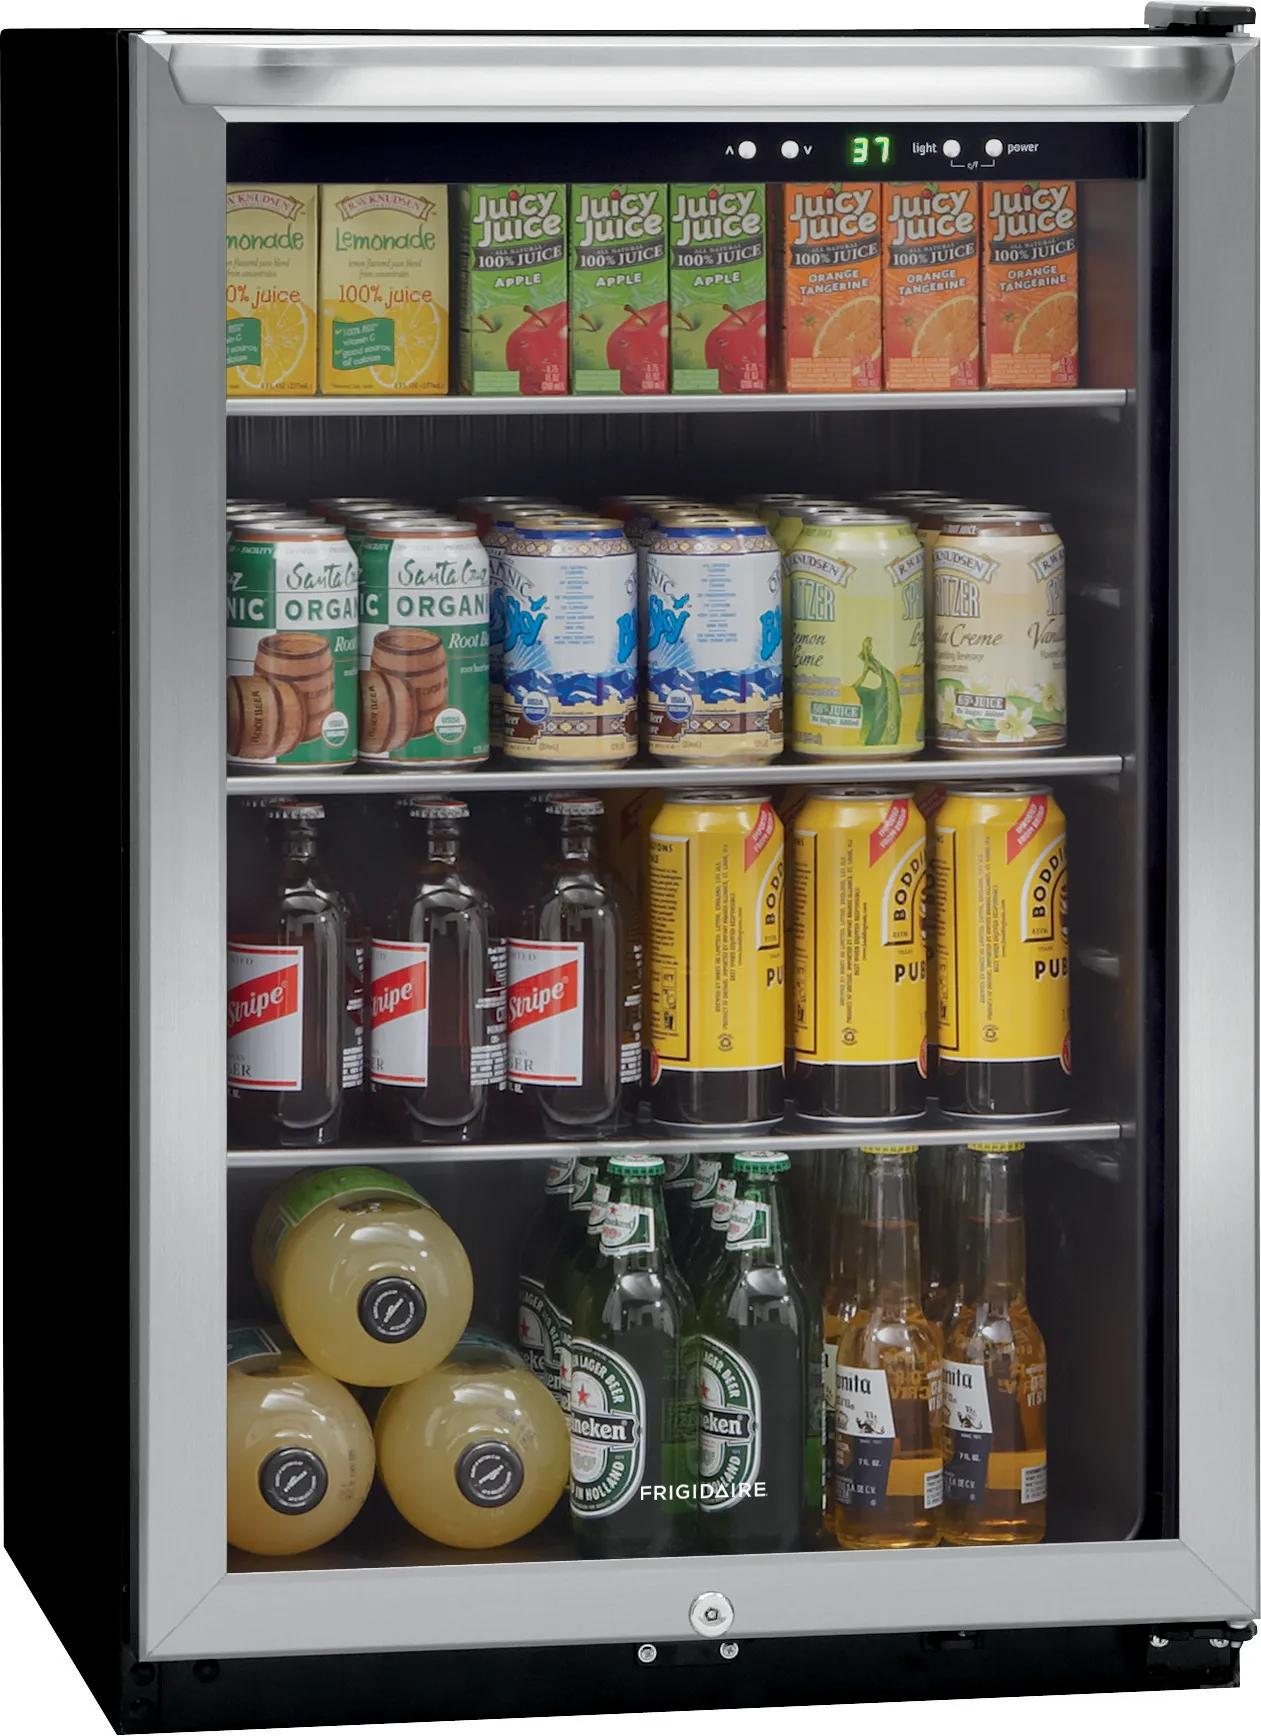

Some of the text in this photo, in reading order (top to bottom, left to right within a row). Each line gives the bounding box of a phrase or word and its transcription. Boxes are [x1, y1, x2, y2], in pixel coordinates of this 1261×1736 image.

[852, 136, 890, 164] 37
[912, 142, 938, 156] light
[1007, 142, 1040, 155] power
[473, 189, 557, 223] Juicy
[575, 188, 657, 222] Juicy
[672, 188, 755, 222] Juicy
[790, 188, 873, 221] Juicy
[888, 189, 969, 221] Juicy
[988, 185, 1069, 218] Juicy
[335, 222, 436, 251] Lemonade
[478, 214, 561, 247] Juice
[580, 214, 662, 247] Juice
[677, 213, 761, 247] Juice
[794, 211, 877, 246] Juice
[892, 212, 974, 246] Juice
[992, 208, 1074, 241] Juice
[479, 245, 562, 268] 100% JUICE
[580, 245, 662, 268] 100% JUICE
[677, 244, 761, 267] 100% JUICE
[795, 242, 878, 266] 100% JUICE
[893, 242, 975, 266] 100% JUICE
[994, 239, 1076, 262] 100% JUICE
[494, 273, 542, 288] APPLE
[596, 272, 642, 287] APPLE
[694, 272, 740, 287] APPLE
[808, 269, 859, 283] ORANGE
[906, 269, 957, 283] ORANGE
[1000, 275, 1067, 292] TANGERINE
[1007, 265, 1057, 279] ORANGE
[251, 286, 302, 310] juice
[338, 284, 433, 309] 100% juice
[800, 278, 869, 295] TANGERINE
[898, 278, 966, 296] TANGERINE
[286, 562, 343, 590] Santa
[398, 559, 459, 586] Santa
[448, 632, 479, 649] Root
[950, 623, 1004, 648] Creme
[974, 697, 1004, 709] JUICE
[894, 960, 926, 984] PUB
[1034, 957, 1067, 979] PUB
[227, 985, 284, 1027] Stripe
[509, 981, 564, 1022] Stripe
[605, 1374, 626, 1404] BEER
[721, 1369, 741, 1399] BEER
[585, 1460, 625, 1501] HOLLAND
[640, 1482, 766, 1501] FRIGIDAIRE
